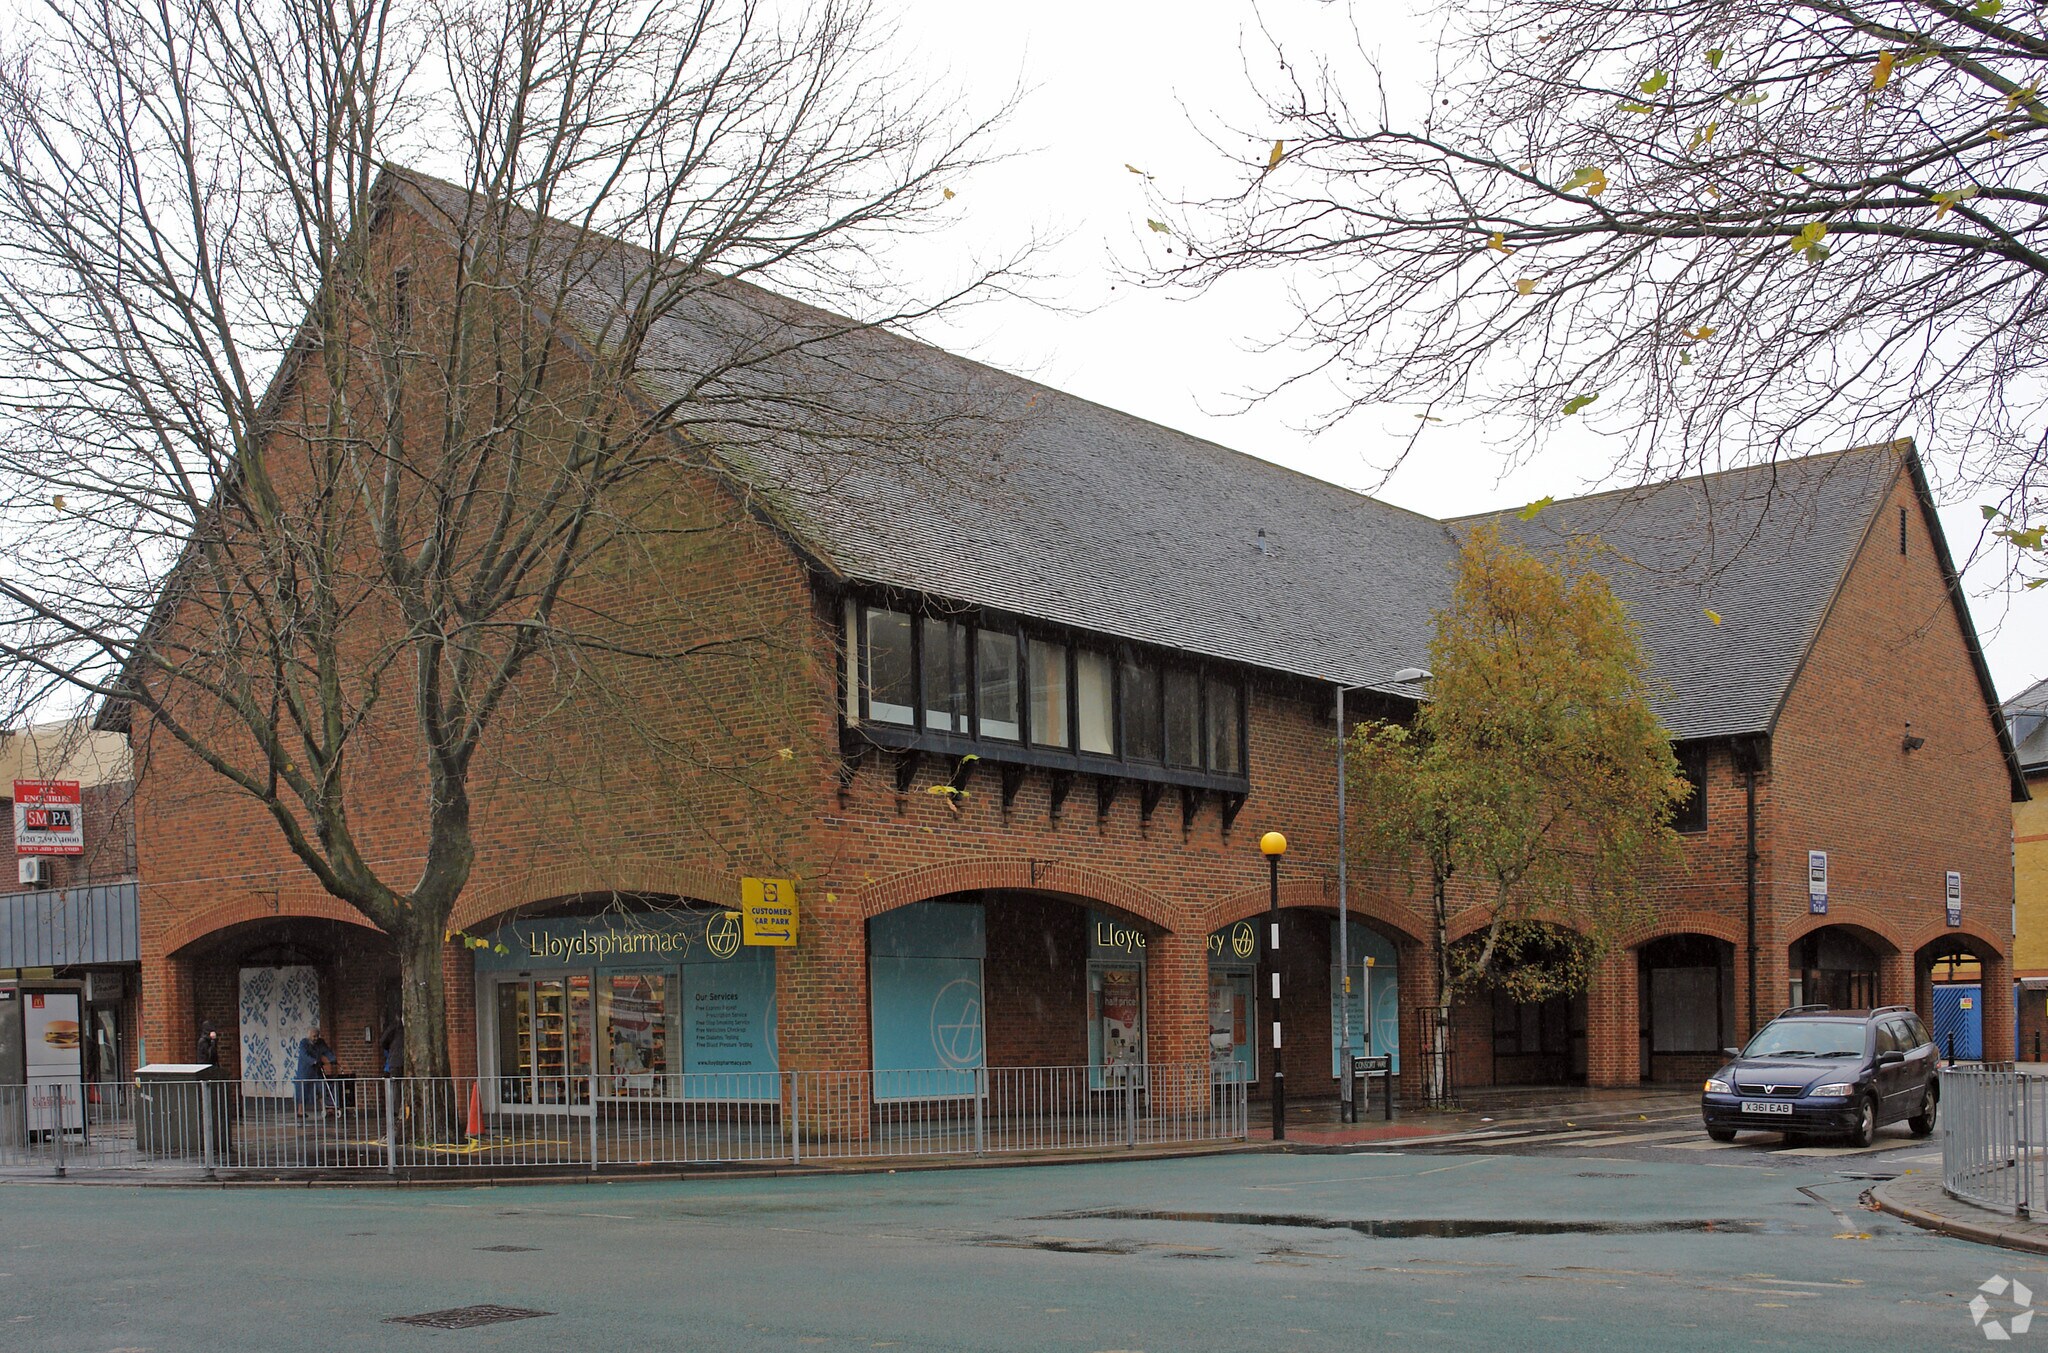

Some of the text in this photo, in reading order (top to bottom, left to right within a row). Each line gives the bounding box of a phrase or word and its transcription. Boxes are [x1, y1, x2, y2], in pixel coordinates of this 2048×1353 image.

[751, 907, 792, 916] CUSTOMERS
[771, 917, 790, 925] PARK
[529, 928, 694, 963] Lloydspharmacy
[695, 992, 738, 1001] Our Services
[1119, 998, 1136, 1007] price
[1355, 1060, 1376, 1070] CONSORT
[1745, 1103, 1789, 1113] X361 EAB
